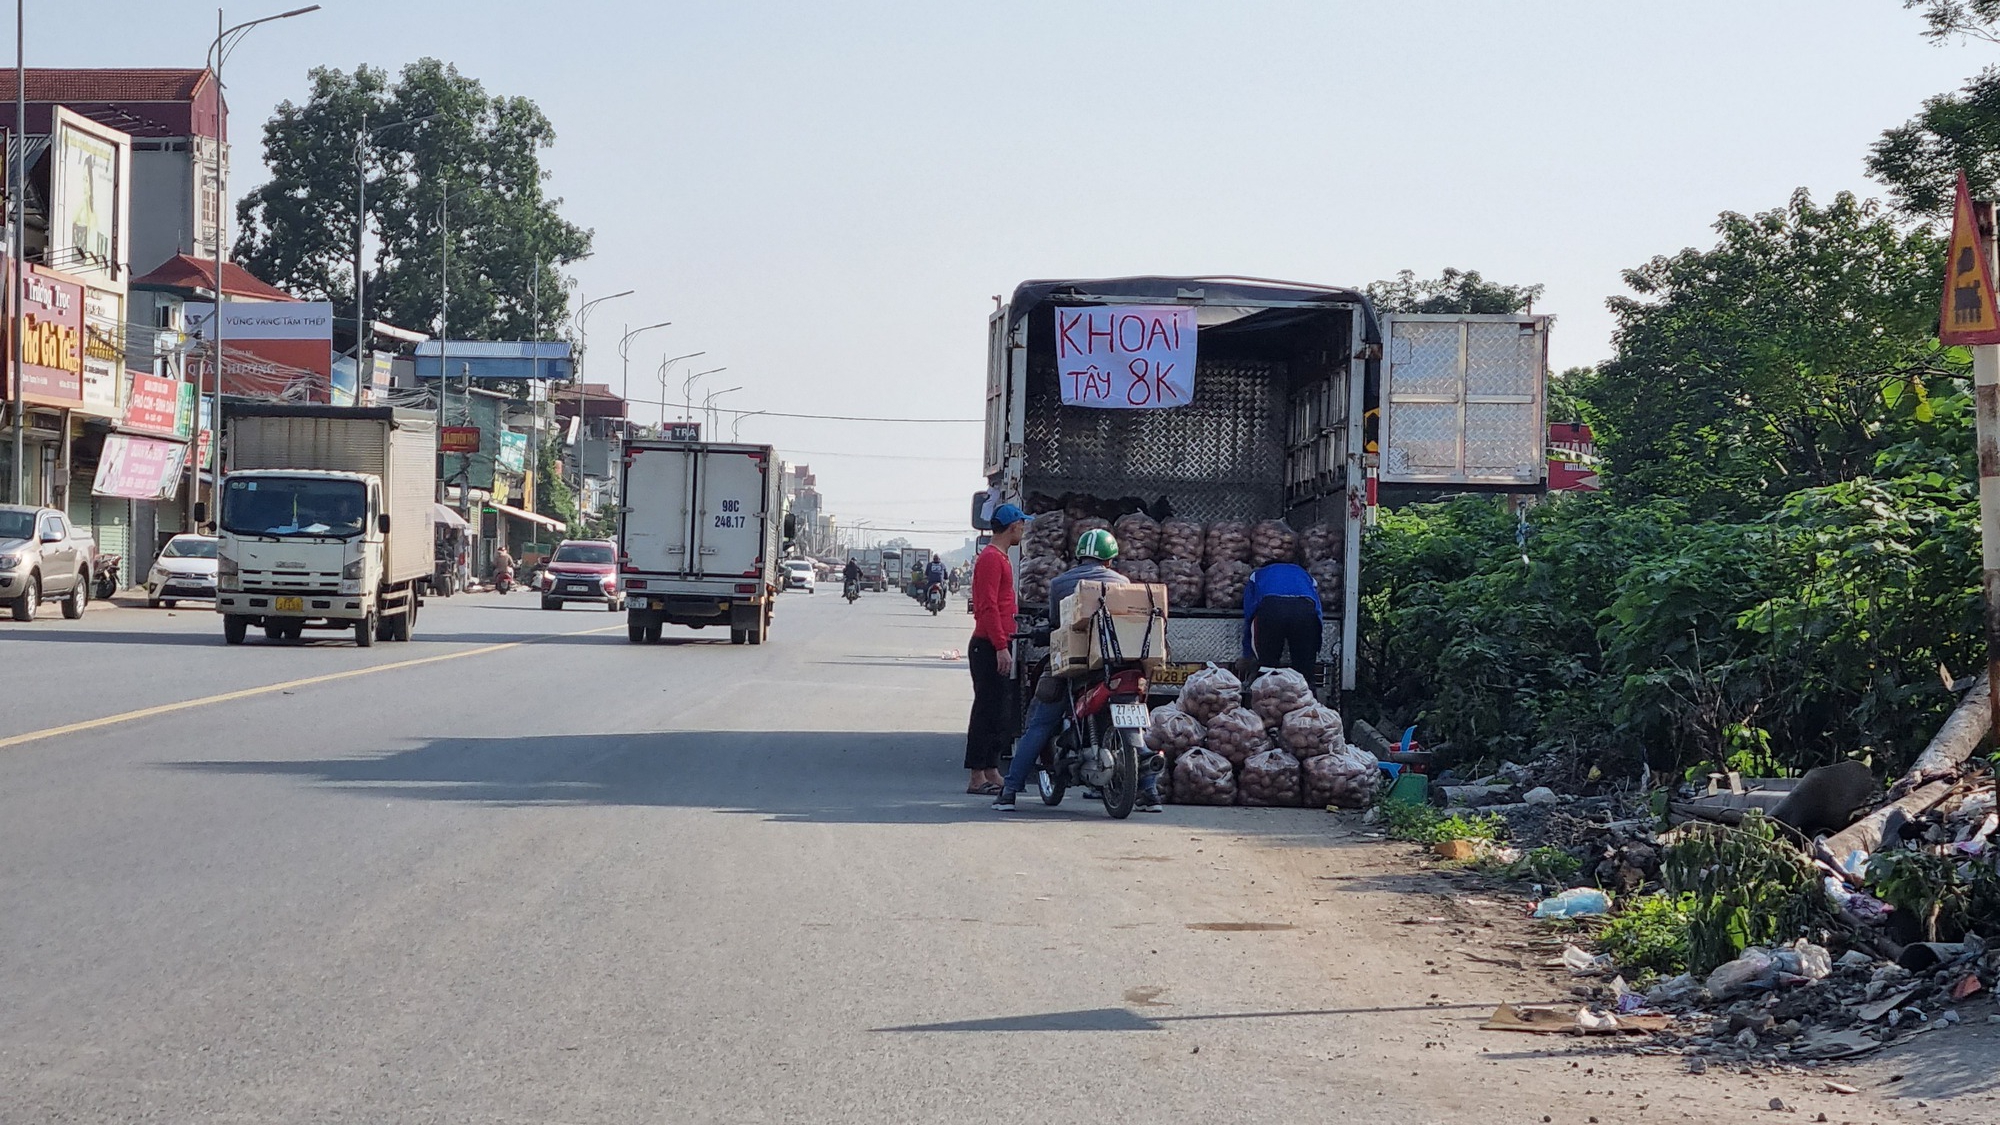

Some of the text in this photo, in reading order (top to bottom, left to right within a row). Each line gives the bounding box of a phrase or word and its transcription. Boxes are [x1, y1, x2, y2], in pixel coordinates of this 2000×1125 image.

[1066, 358, 1177, 406] TÂY 8K
[722, 500, 740, 512] 98C
[714, 516, 746, 529] 248.17
